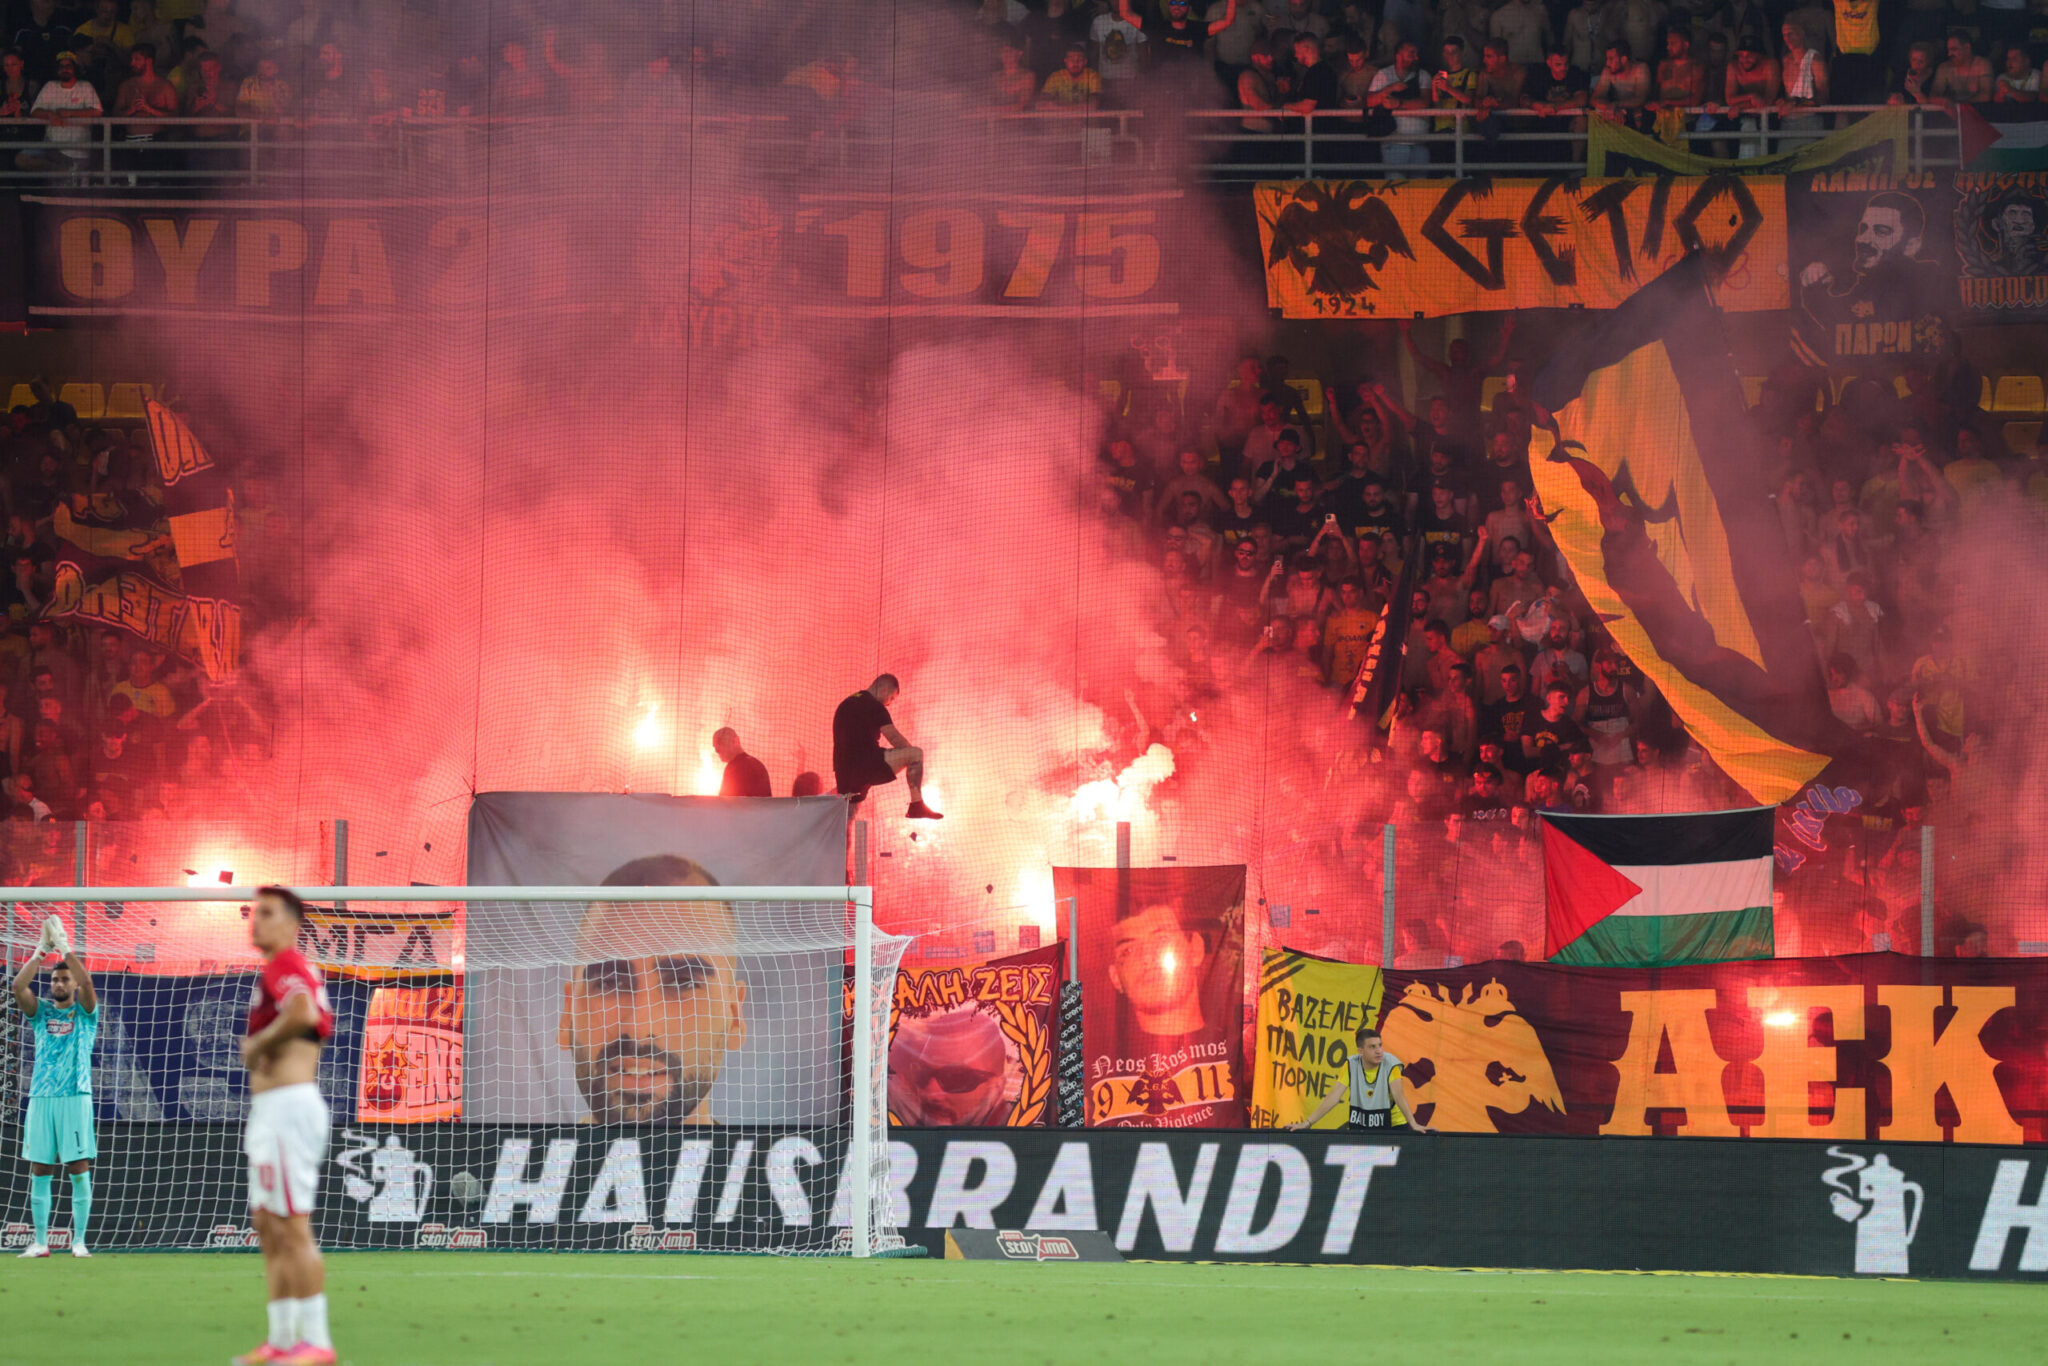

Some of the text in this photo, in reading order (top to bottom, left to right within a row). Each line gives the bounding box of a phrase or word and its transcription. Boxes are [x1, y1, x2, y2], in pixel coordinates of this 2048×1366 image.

[59, 213, 396, 306] ΘΥΡΑ
[823, 208, 1162, 300] 1975
[1313, 295, 1376, 316] 1924
[843, 966, 1052, 1019] ΜΧΑΛΗ ΖΕΙΣ
[1277, 988, 1376, 1031] ΒΑΖΕΛΕΣ
[1092, 1055, 1146, 1079] Neos
[1267, 1025, 1348, 1069] ΠΑΛΙΟ
[1599, 985, 2023, 1145] AEK
[1097, 1064, 1225, 1118] 9 11
[1273, 1060, 1343, 1103] ΠΟΡΝΕ
[74, 1130, 81, 1147] 1
[1155, 1106, 1213, 1128] Violence
[1350, 1111, 1384, 1127] BAL BOY
